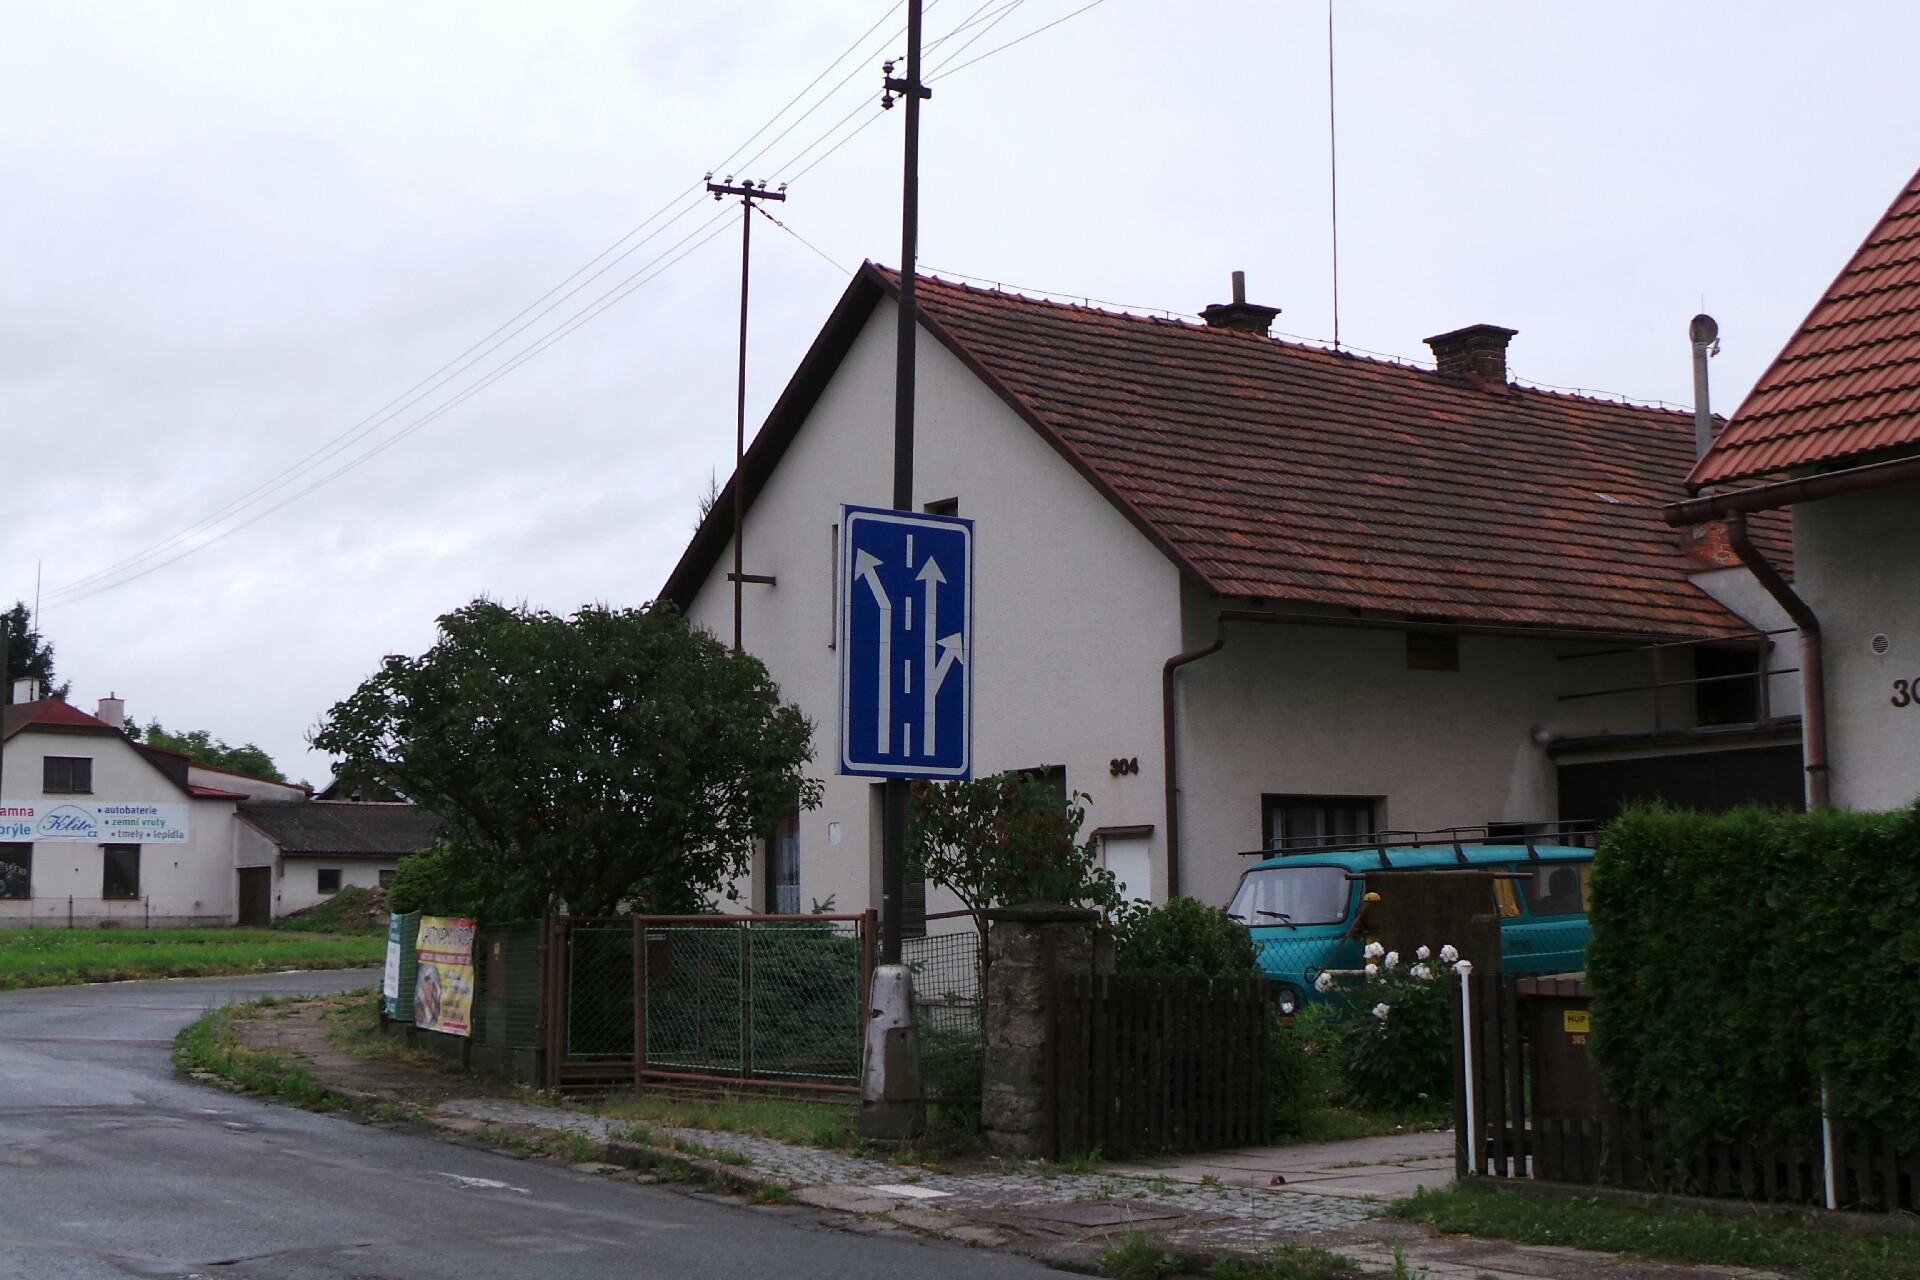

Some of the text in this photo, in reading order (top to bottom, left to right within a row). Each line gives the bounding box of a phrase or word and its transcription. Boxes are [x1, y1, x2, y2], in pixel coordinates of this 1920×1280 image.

[1110, 758, 1139, 776] 304
[104, 805, 157, 815] autobaterie
[112, 817, 166, 828] zemní vruty
[118, 829, 184, 840] tmely lepidla
[1568, 1015, 1586, 1023] HUP
